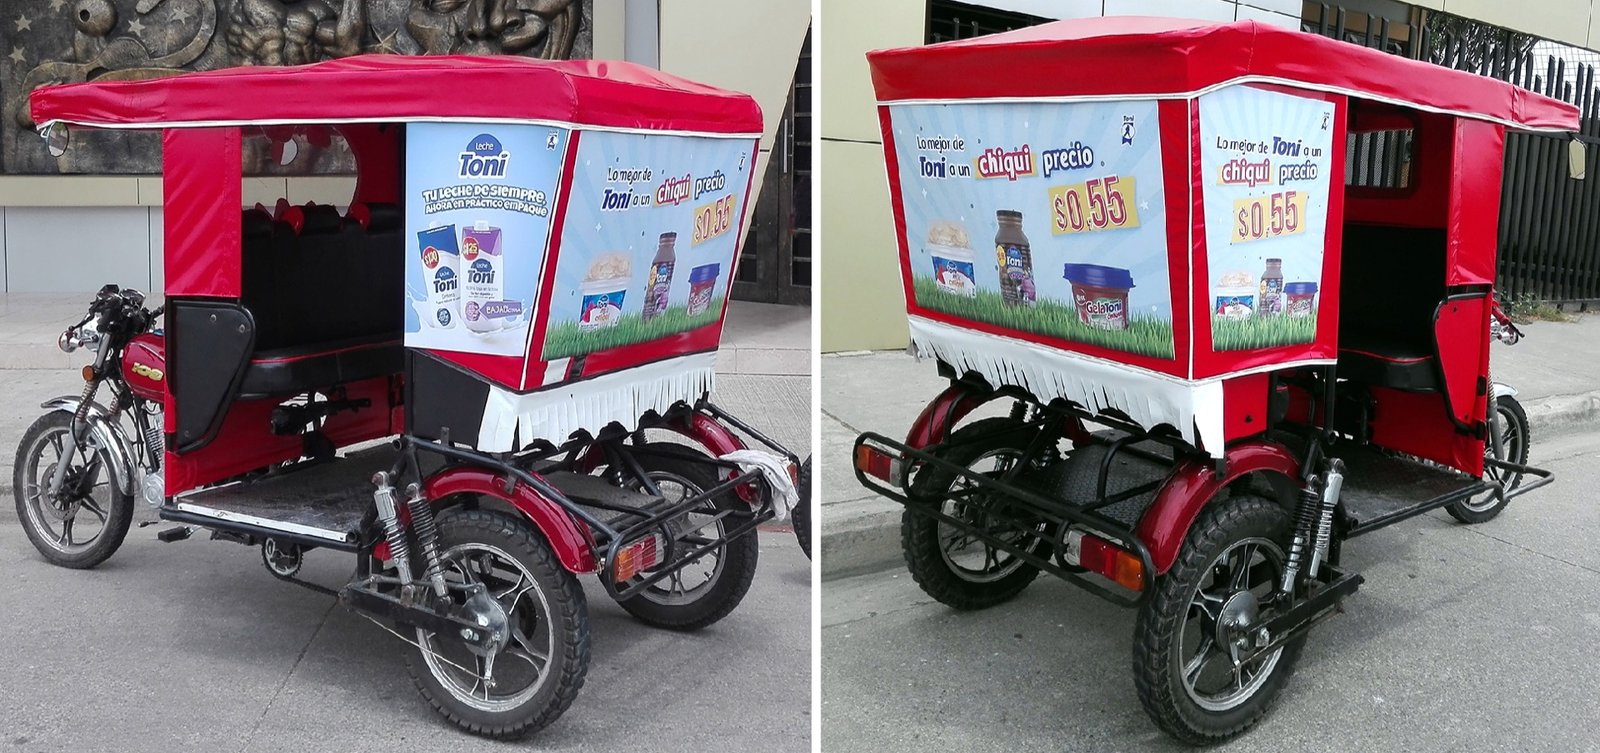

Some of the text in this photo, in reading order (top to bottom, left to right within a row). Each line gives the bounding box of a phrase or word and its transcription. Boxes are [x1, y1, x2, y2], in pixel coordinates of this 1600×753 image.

[475, 142, 494, 151] Leche
[917, 135, 964, 152] Lo mejor de
[1217, 136, 1322, 157] Lo mejor de Toni a un
[460, 154, 508, 177] Toni
[920, 140, 1094, 181] Toni a un chiqui precio
[608, 168, 651, 185] Lo mejor de
[1222, 158, 1318, 188] chiqui precio
[602, 169, 726, 209] Toni a un chiqui precio
[1007, 255, 1023, 267] Toni
[433, 275, 458, 293] Toni
[467, 270, 496, 284] Toni
